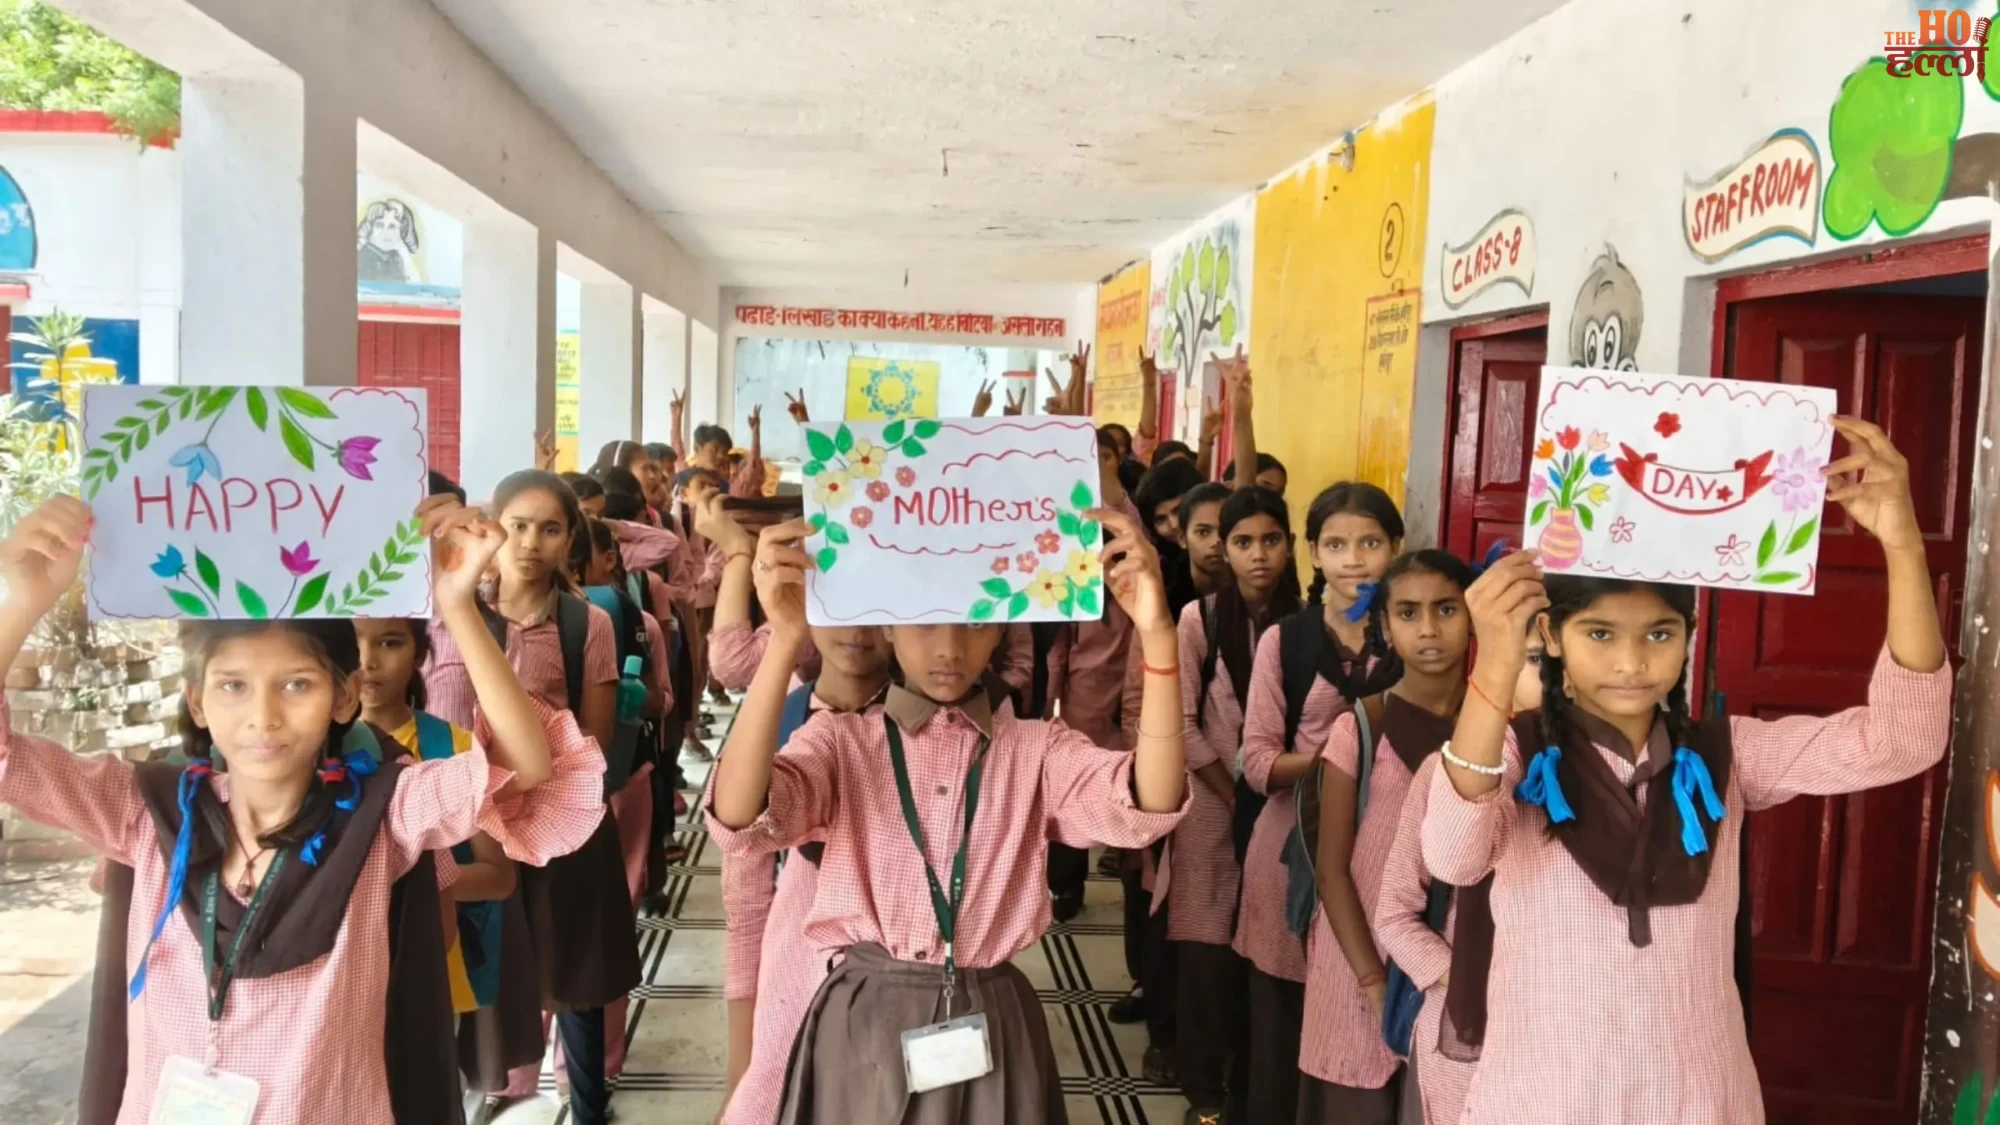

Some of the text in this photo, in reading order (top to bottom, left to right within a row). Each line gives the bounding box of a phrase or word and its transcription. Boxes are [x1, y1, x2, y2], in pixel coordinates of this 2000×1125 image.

[1691, 158, 1815, 244] STAFFROOM
[134, 475, 345, 538] HAPPY
[1652, 468, 1717, 500] DAY
